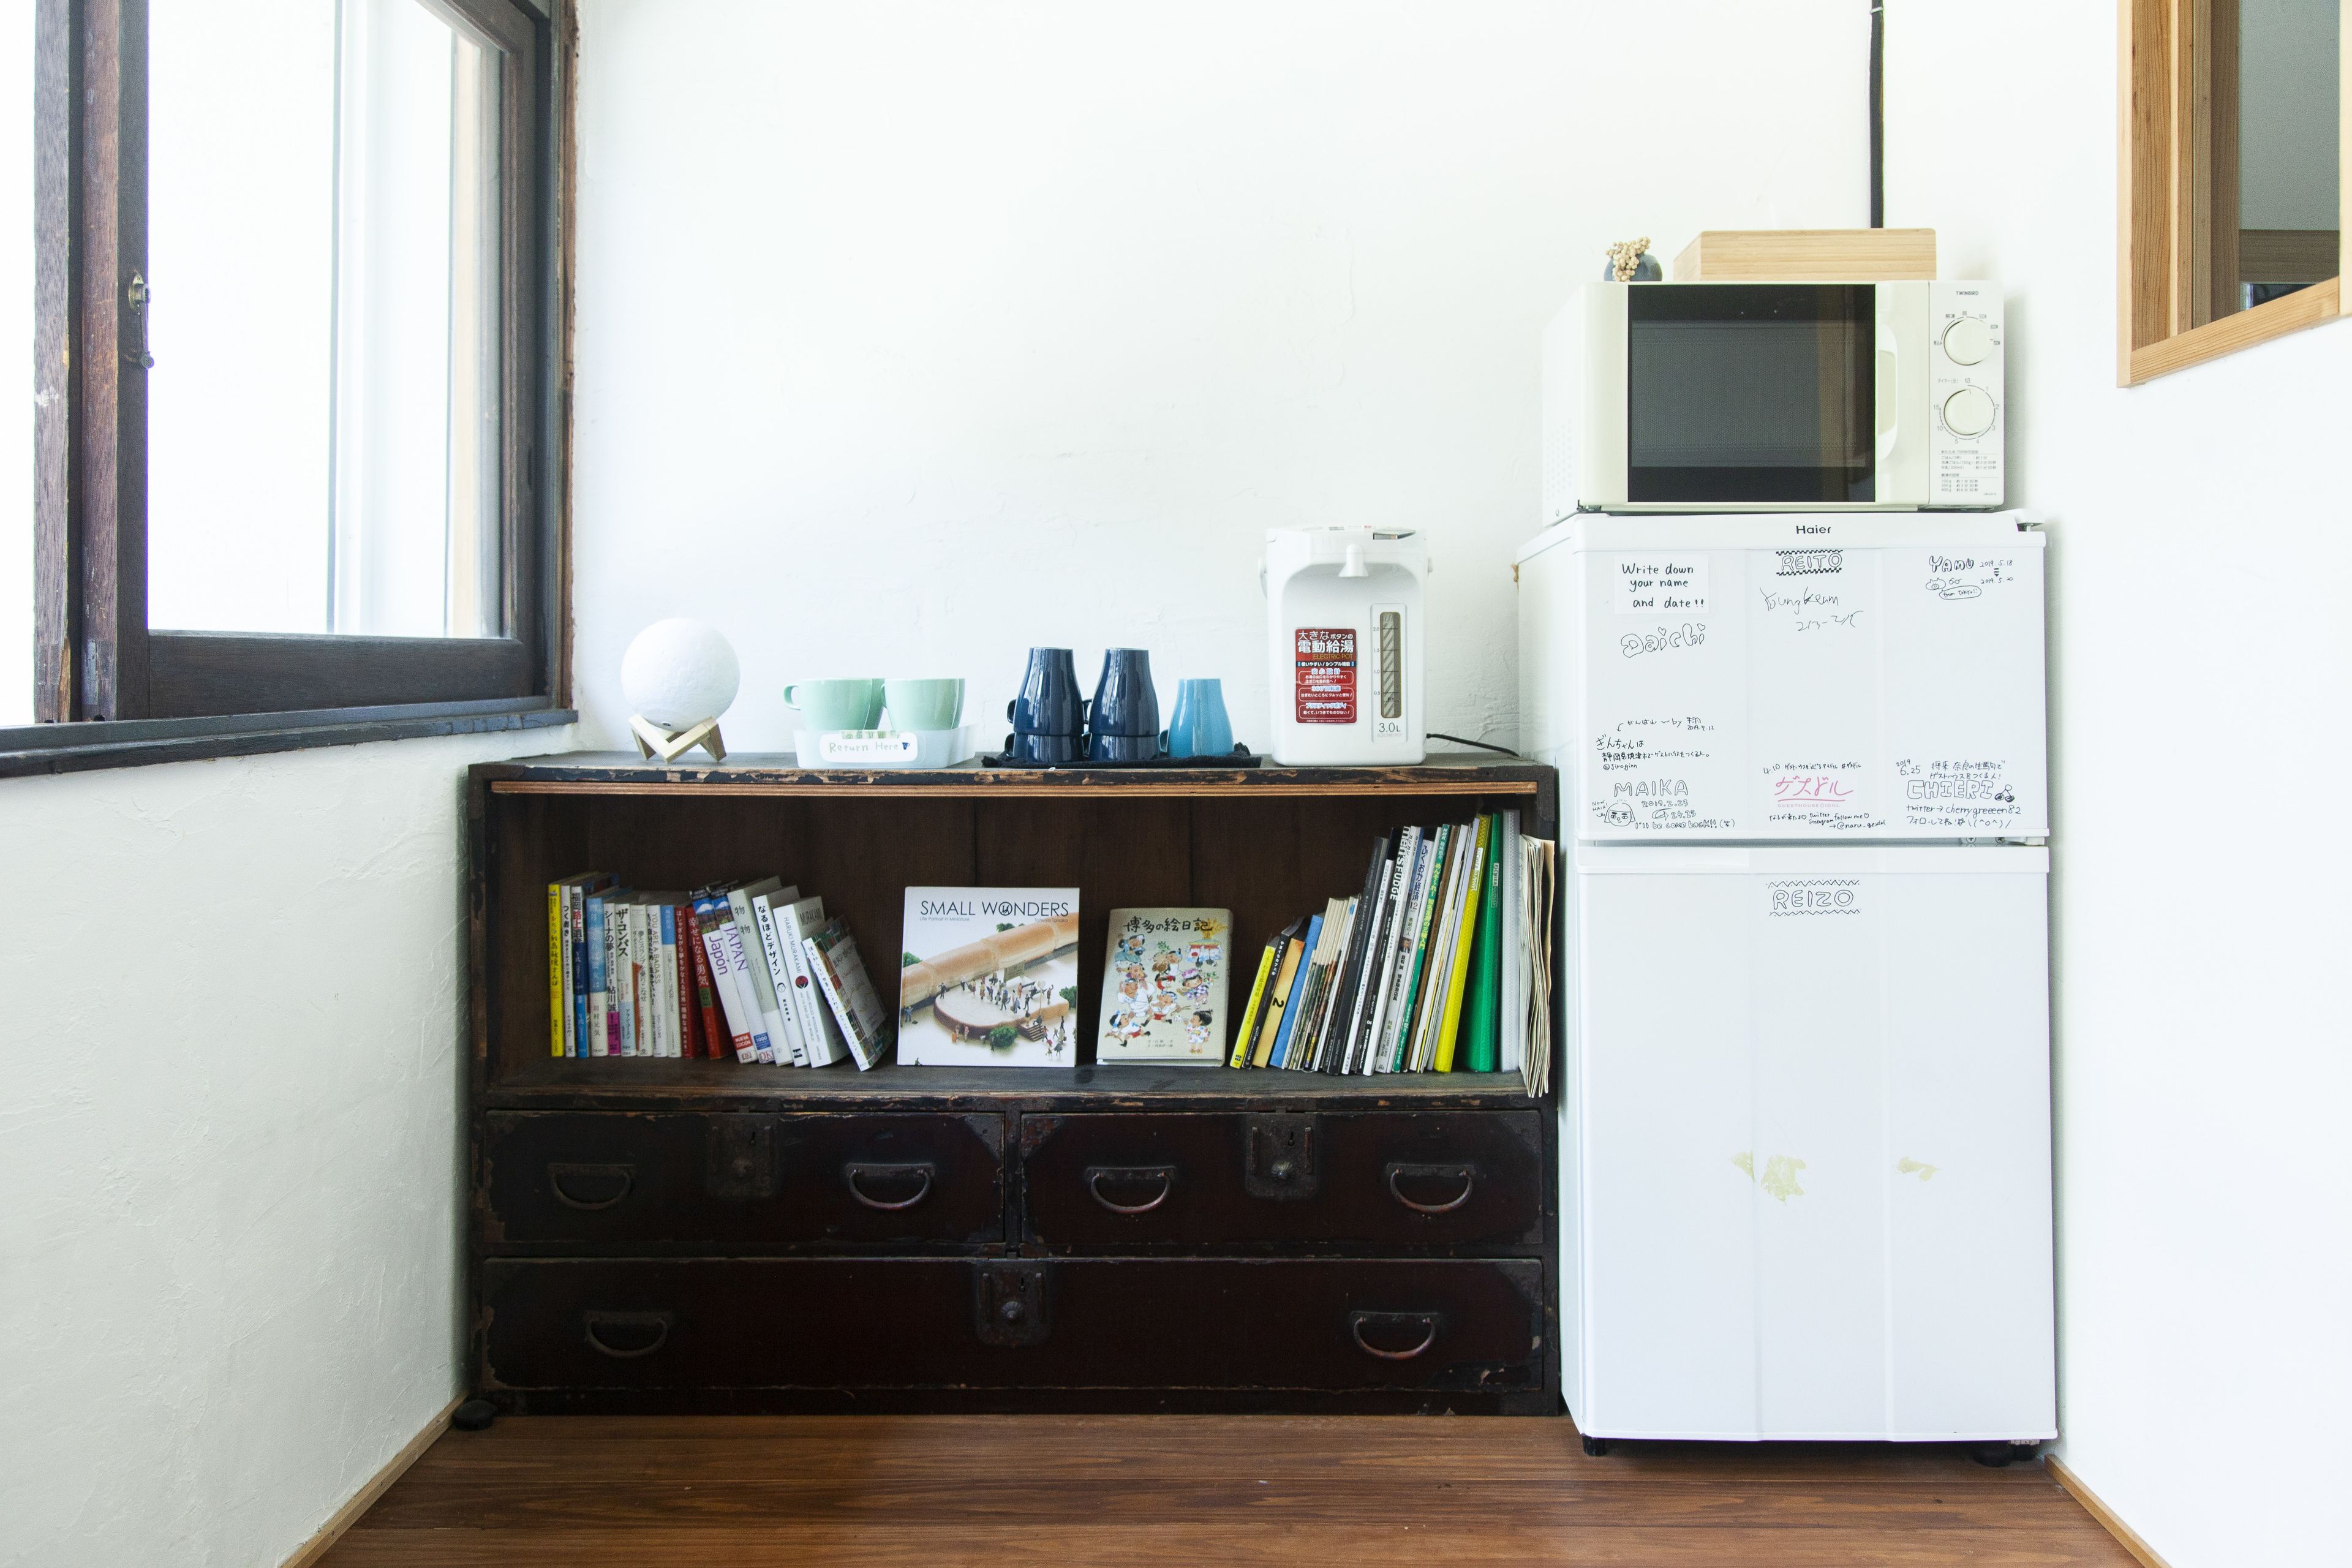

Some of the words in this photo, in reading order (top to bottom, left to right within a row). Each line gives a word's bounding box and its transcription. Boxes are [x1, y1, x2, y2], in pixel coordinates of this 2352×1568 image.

[1796, 525, 1831, 534] Haier
[1622, 563, 1659, 575] Write
[1665, 563, 1694, 575] down
[1781, 552, 1842, 571] REITO
[1929, 556, 1974, 573] YAMU
[1629, 579, 1654, 592] your
[1633, 597, 1654, 608] and
[1298, 630, 1354, 640] 大きなボタンの
[1297, 639, 1354, 654] 電動給湯
[1379, 722, 1401, 733] 3.0L
[1672, 718, 1683, 728] by
[829, 742, 869, 753] Return
[875, 742, 899, 750] Here
[1900, 765, 1921, 775] 6.25
[1614, 779, 1689, 797] MAIKA
[1906, 780, 1994, 799] CHIERI
[1834, 813, 1852, 821] follow
[1412, 845, 1428, 901] ふくおか経済
[1409, 901, 1419, 910] 12
[1773, 889, 1853, 910] REIZO
[920, 900, 976, 916] SMALL
[982, 901, 1069, 917] WONDERS
[604, 911, 614, 951] シーナの夢
[616, 908, 628, 956] ザ・コンパス
[1123, 916, 1213, 933] 博多の絵日記
[723, 926, 748, 971] JAPAN
[758, 905, 781, 975] なるほどデザイン
[784, 916, 793, 939] HARUKI
[789, 939, 802, 974] MURAKAMI
[688, 917, 709, 986] 幸せになる勇気
[709, 936, 729, 975] Japón
[1272, 997, 1284, 1008] 2
[761, 1050, 773, 1060] DK
